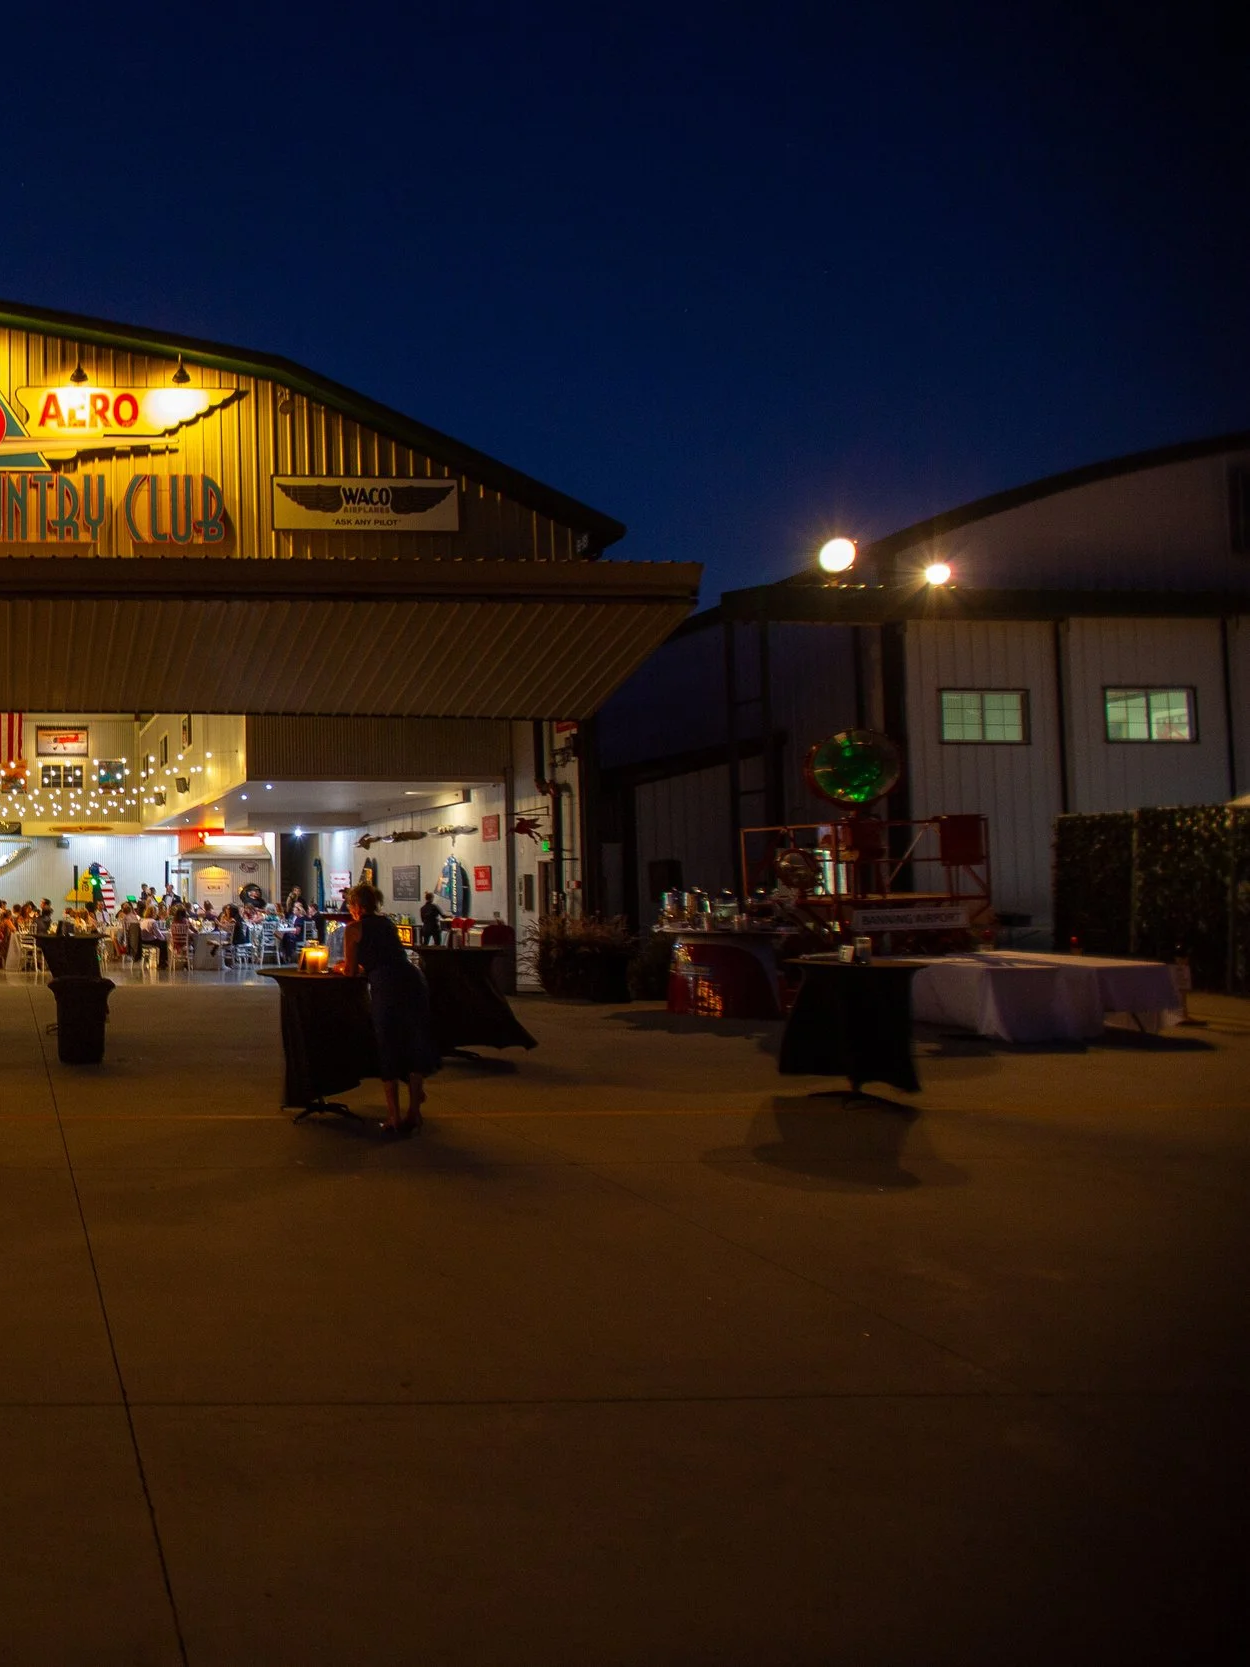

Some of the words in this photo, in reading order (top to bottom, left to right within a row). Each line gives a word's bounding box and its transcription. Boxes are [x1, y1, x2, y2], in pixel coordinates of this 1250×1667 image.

[38, 393, 139, 428] AERO
[124, 473, 227, 545] CLUB
[341, 487, 390, 506] WACO
